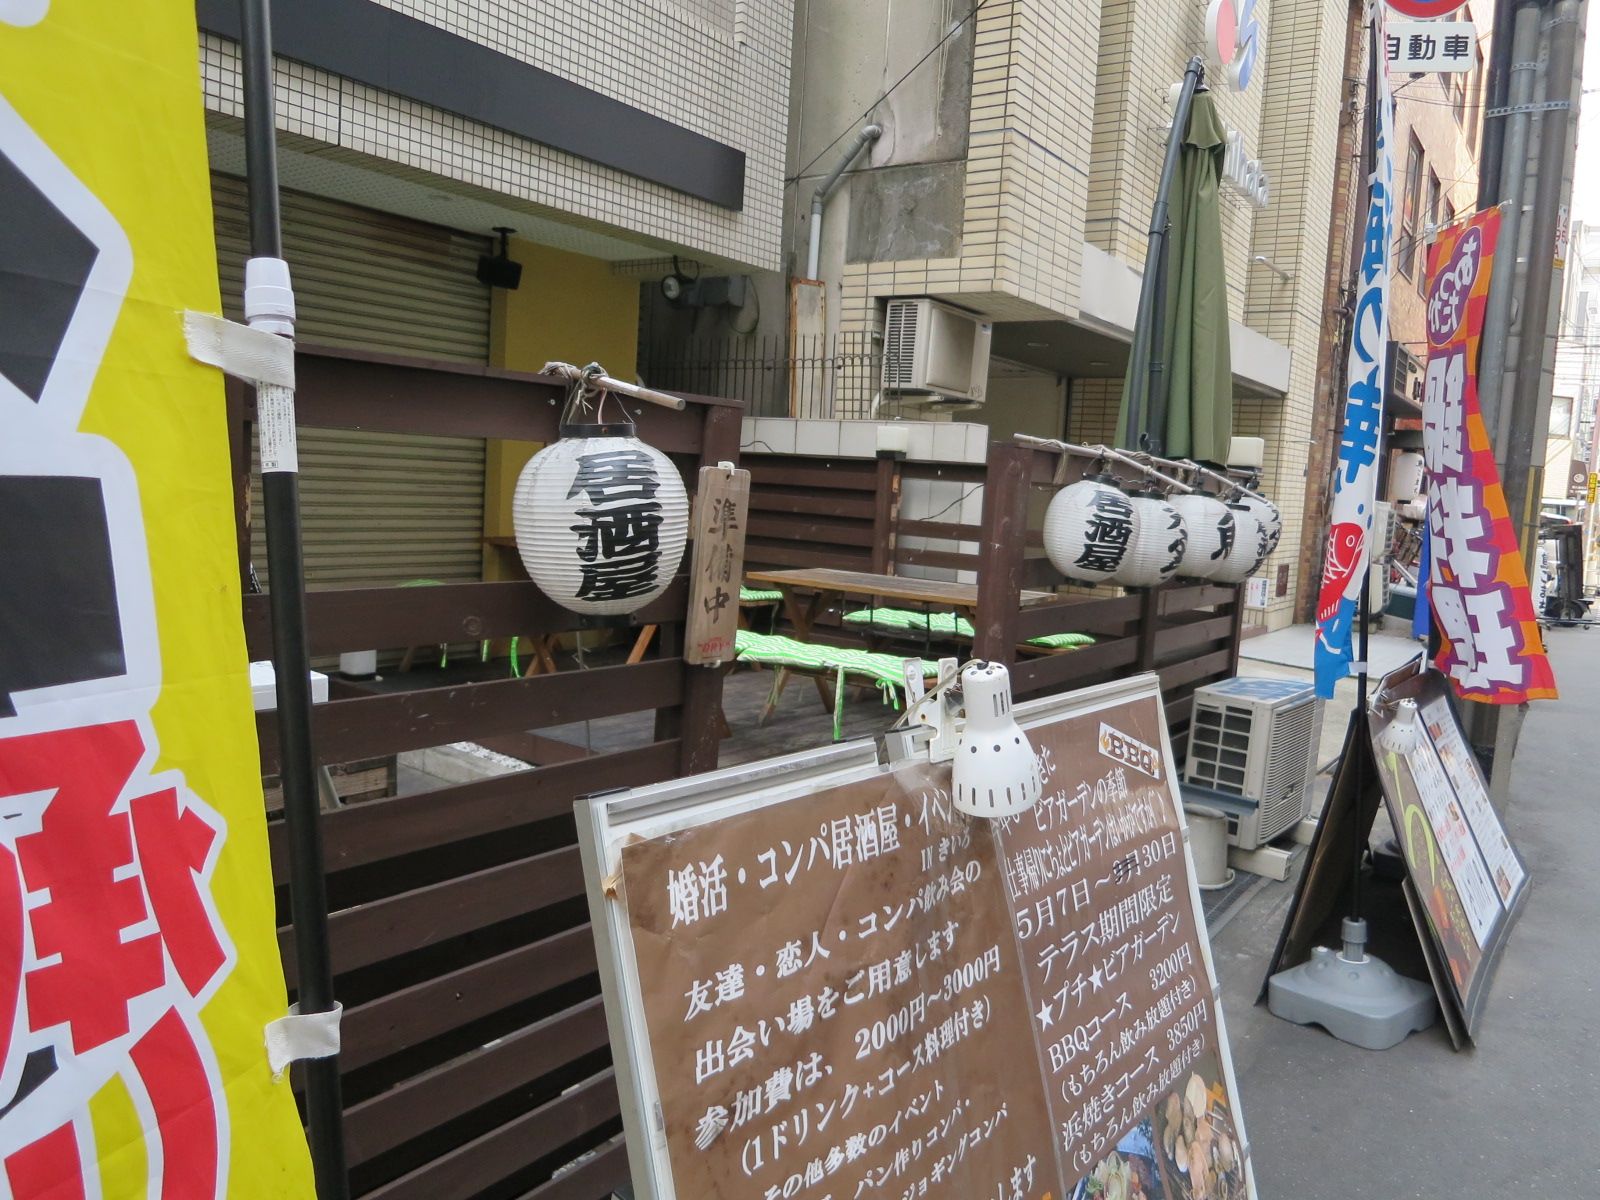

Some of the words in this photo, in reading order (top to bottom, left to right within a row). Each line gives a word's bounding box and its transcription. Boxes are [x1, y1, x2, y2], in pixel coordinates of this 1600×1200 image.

[1387, 33, 1470, 61] 自動車
[567, 450, 665, 602] 居酒屋
[704, 497, 739, 625] 準備中
[1073, 489, 1134, 573] 居酒屋
[1107, 733, 1155, 776] BBQ
[667, 787, 953, 930] 婚活・コンパ居酒屋・イベン
[684, 860, 981, 1023] 友達・恋人・コンパ飲み会の
[1037, 873, 1175, 984] テラス期間限定
[695, 921, 959, 1085] 出会い場をご用意します
[1047, 991, 1133, 1074] BBQコース
[1149, 942, 1193, 991] 3200円
[1061, 973, 1197, 1104] (もちろん飲み放題付き)
[694, 1052, 833, 1151] 参加費は、
[1062, 1045, 1160, 1152] 浜焼きコース
[1166, 998, 1208, 1051] 3850円
